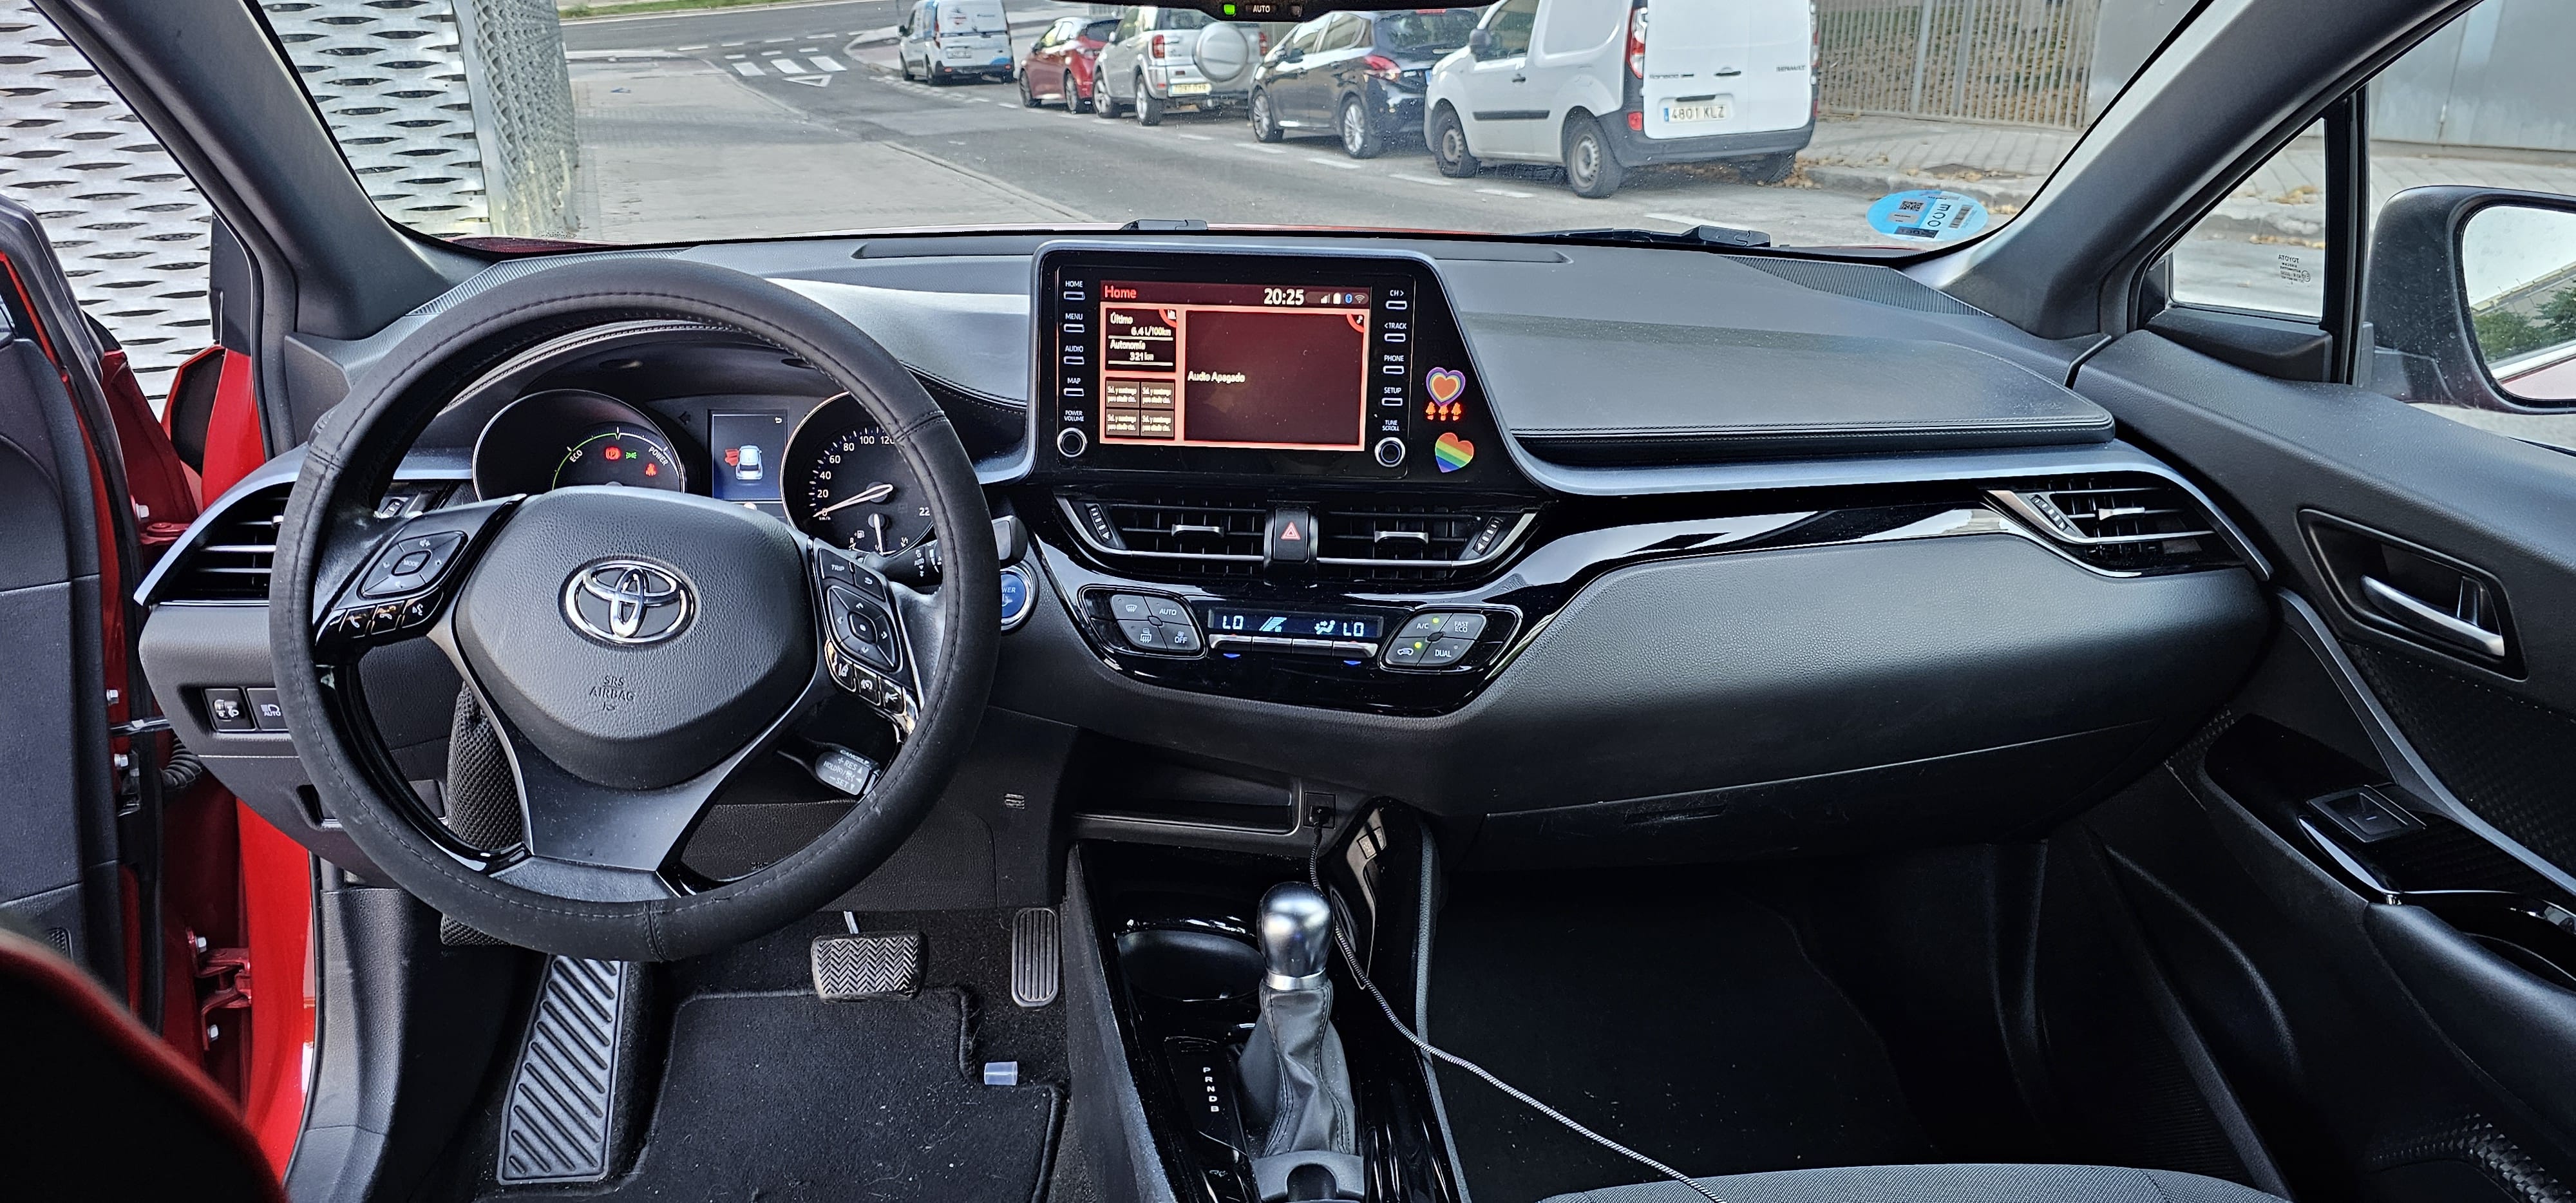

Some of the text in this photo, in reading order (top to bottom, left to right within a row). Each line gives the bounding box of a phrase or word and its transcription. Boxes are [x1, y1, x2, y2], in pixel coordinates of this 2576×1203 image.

[1672, 106, 1725, 119] 4801 KLZ
[1104, 285, 1137, 298] Home
[1264, 288, 1305, 305] 20:25
[1110, 312, 1133, 325] Último
[1130, 352, 1143, 361] 321
[1188, 371, 1245, 384] Audio Apagado
[860, 436, 875, 444] 100
[569, 450, 583, 462] ECO
[648, 446, 668, 466] POWER
[829, 455, 840, 464] 60
[820, 471, 831, 480] 40
[817, 489, 829, 498] 20
[919, 507, 931, 516] 22
[914, 558, 925, 566] AUTO
[1222, 615, 1244, 630] LO
[1343, 622, 1364, 637] LO
[603, 675, 625, 687] SRS
[589, 687, 634, 701] AIRBAG
